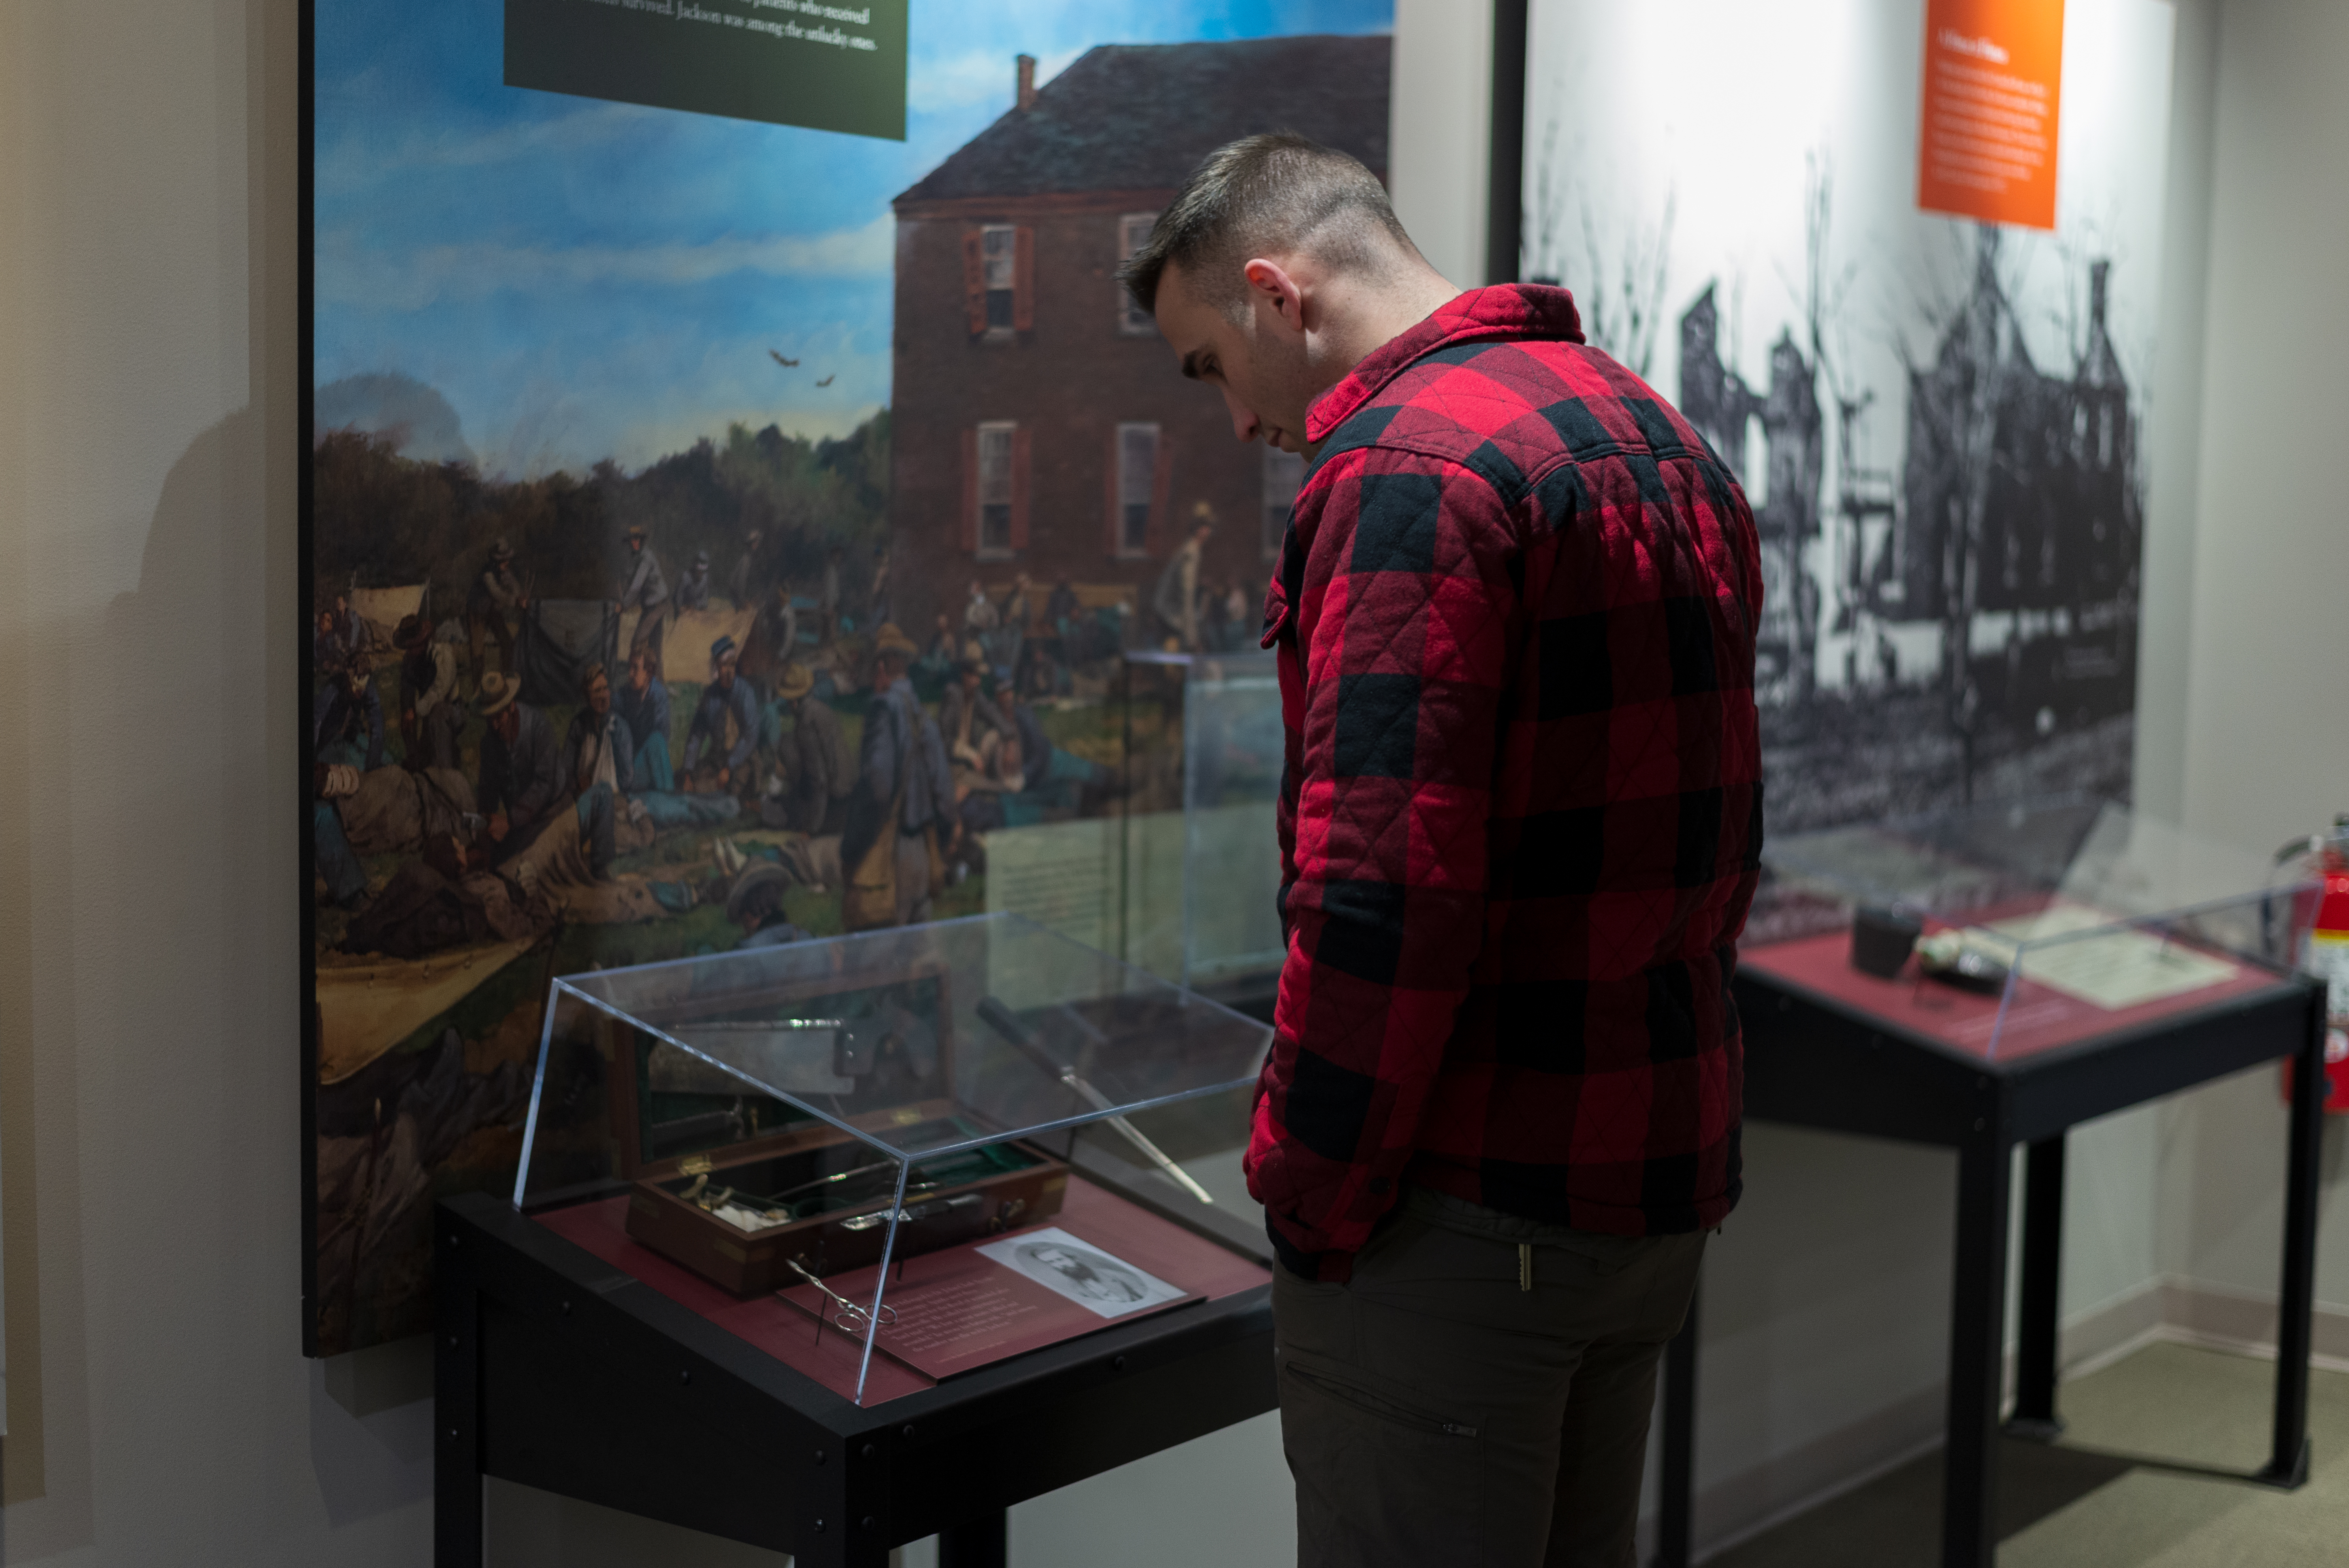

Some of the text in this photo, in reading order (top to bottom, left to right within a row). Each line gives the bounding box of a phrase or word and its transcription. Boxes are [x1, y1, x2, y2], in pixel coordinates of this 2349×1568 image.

[675, 0, 721, 24] Jackson
[723, 14, 745, 27] was
[745, 18, 784, 38] among
[784, 20, 804, 38] the
[804, 25, 848, 49] unlucky
[799, 0, 824, 16] who
[823, 6, 870, 24] received
